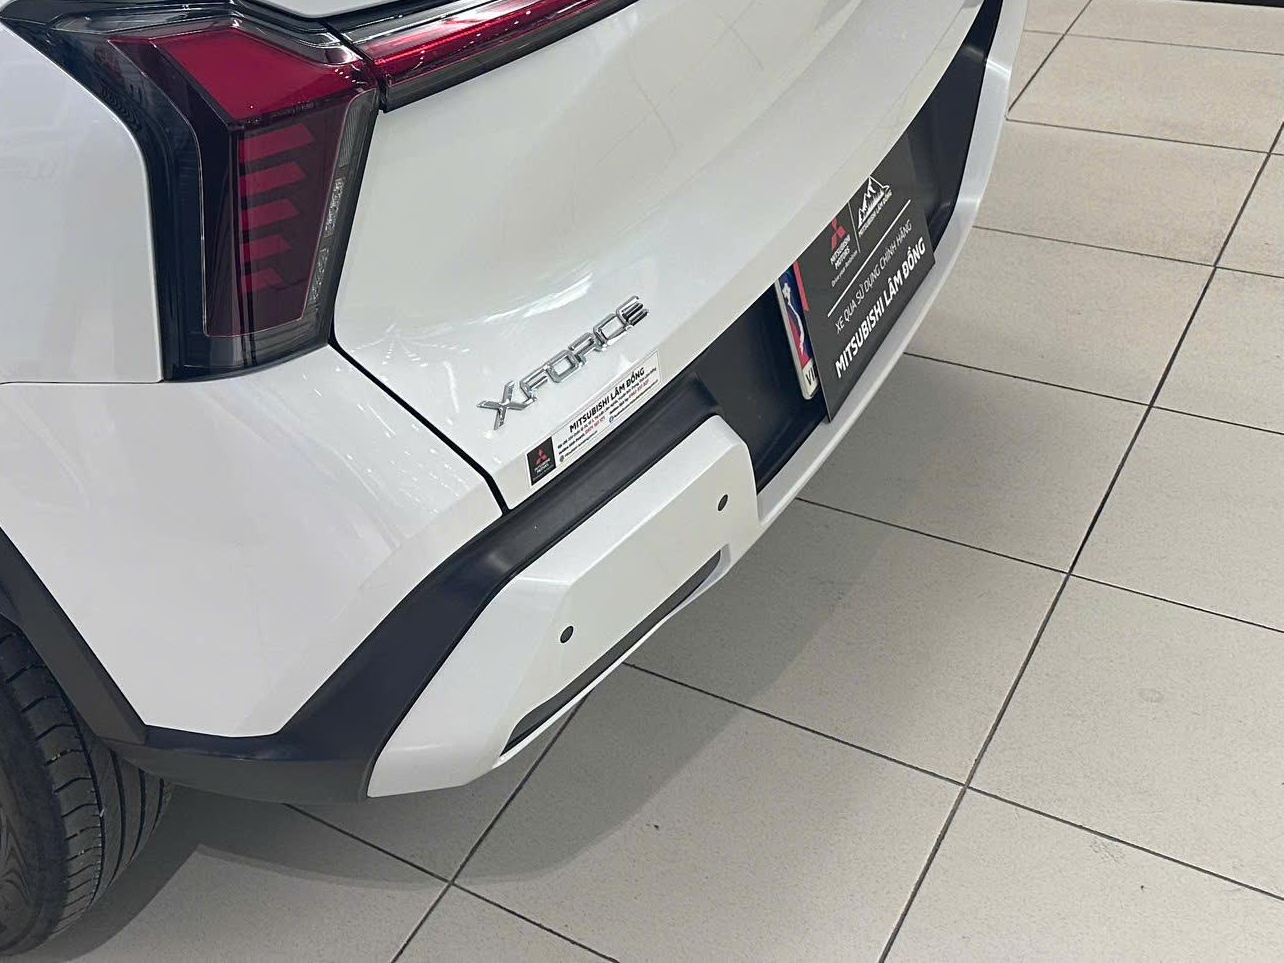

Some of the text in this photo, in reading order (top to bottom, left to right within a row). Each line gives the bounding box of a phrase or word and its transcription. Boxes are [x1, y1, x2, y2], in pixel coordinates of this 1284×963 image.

[835, 245, 851, 269] MOTORS
[835, 316, 845, 334] XE
[843, 299, 858, 322] QUA
[863, 263, 881, 293] DỤNG
[835, 236, 927, 379] MITSUBISHI LÂM ĐỒNG
[476, 295, 650, 430] XFORCE
[569, 397, 610, 434] MITSUBISHI
